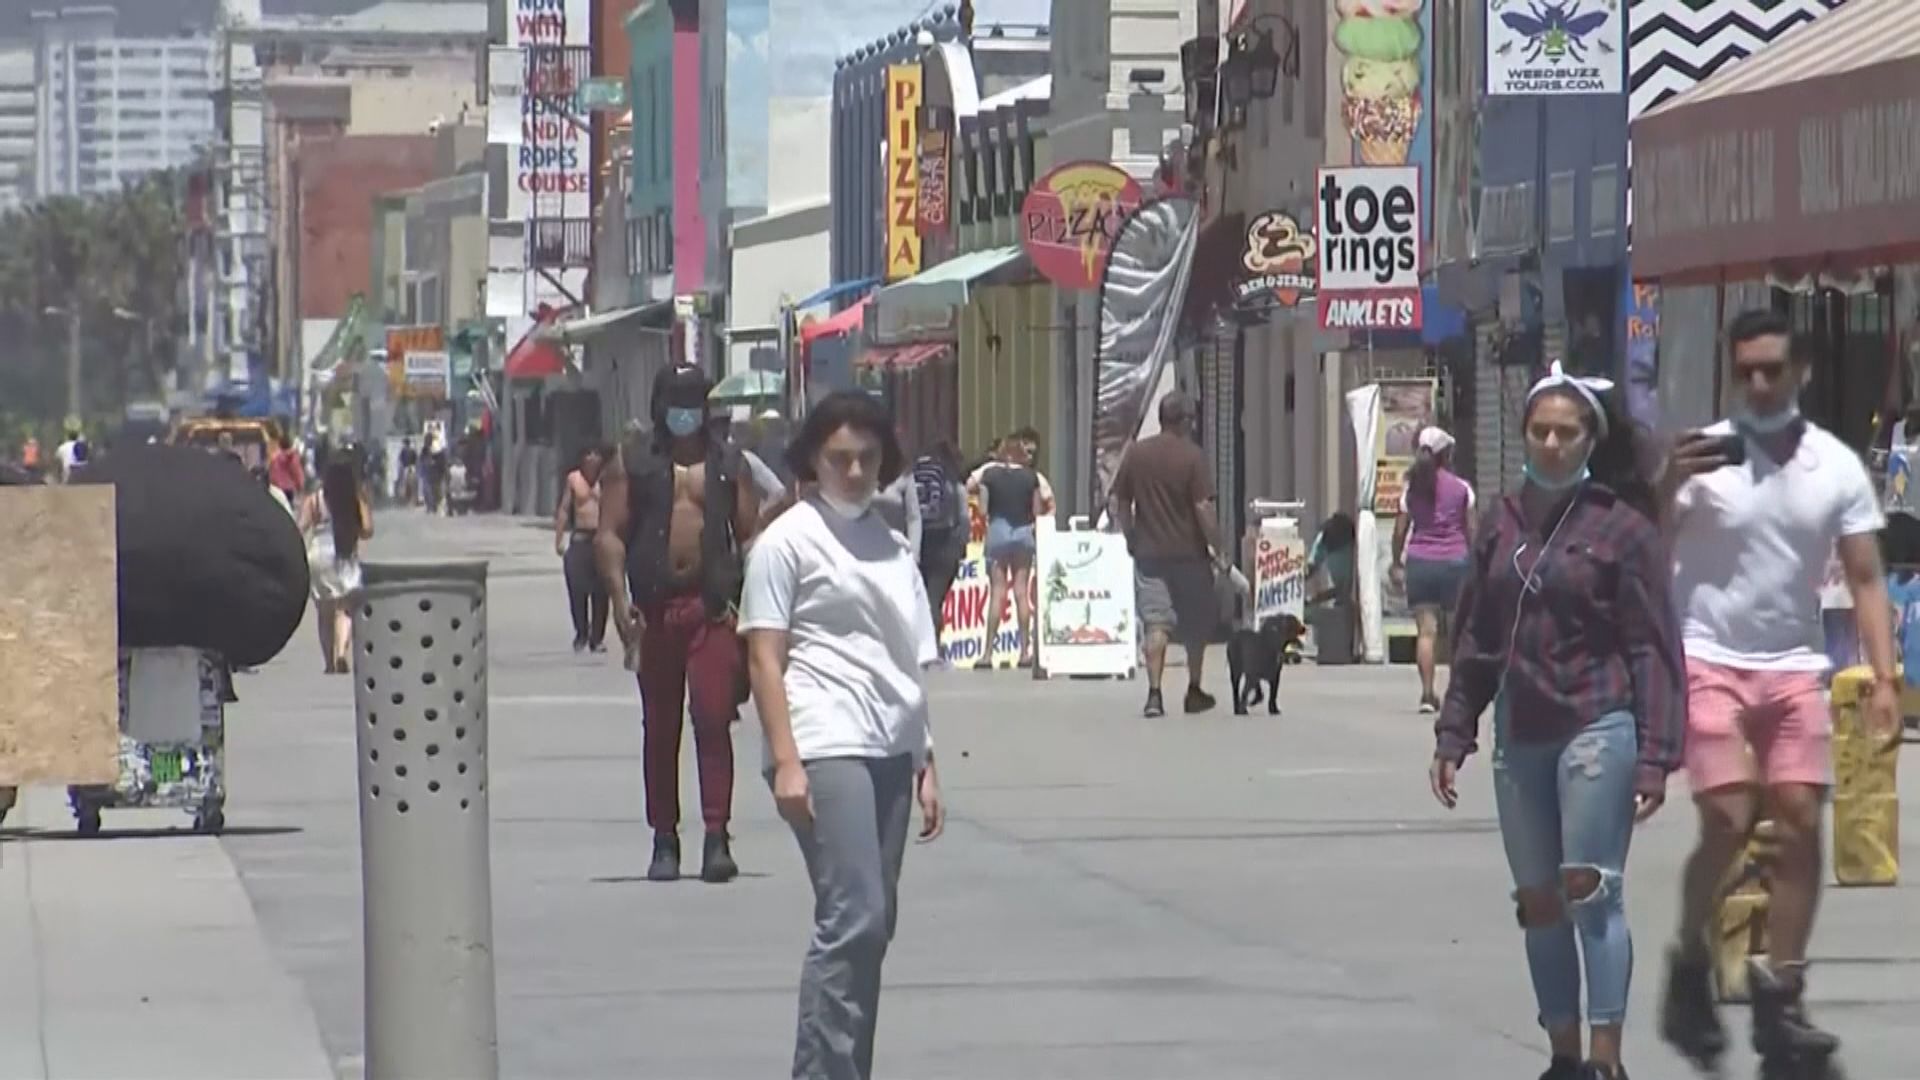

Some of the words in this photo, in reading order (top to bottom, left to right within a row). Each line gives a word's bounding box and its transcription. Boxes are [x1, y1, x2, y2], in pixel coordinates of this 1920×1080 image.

[516, 14, 566, 38] WITH
[1505, 80, 1604, 91] TOURS.COM
[1508, 68, 1600, 79] WEEDBUZZ
[519, 147, 577, 169] ROPES
[518, 173, 588, 193] COURSE
[895, 80, 915, 265] PIZZA
[1321, 175, 1415, 235] toe
[1325, 234, 1415, 283] rings
[1325, 297, 1414, 327] ANKLETS
[943, 637, 982, 663] MIDI
